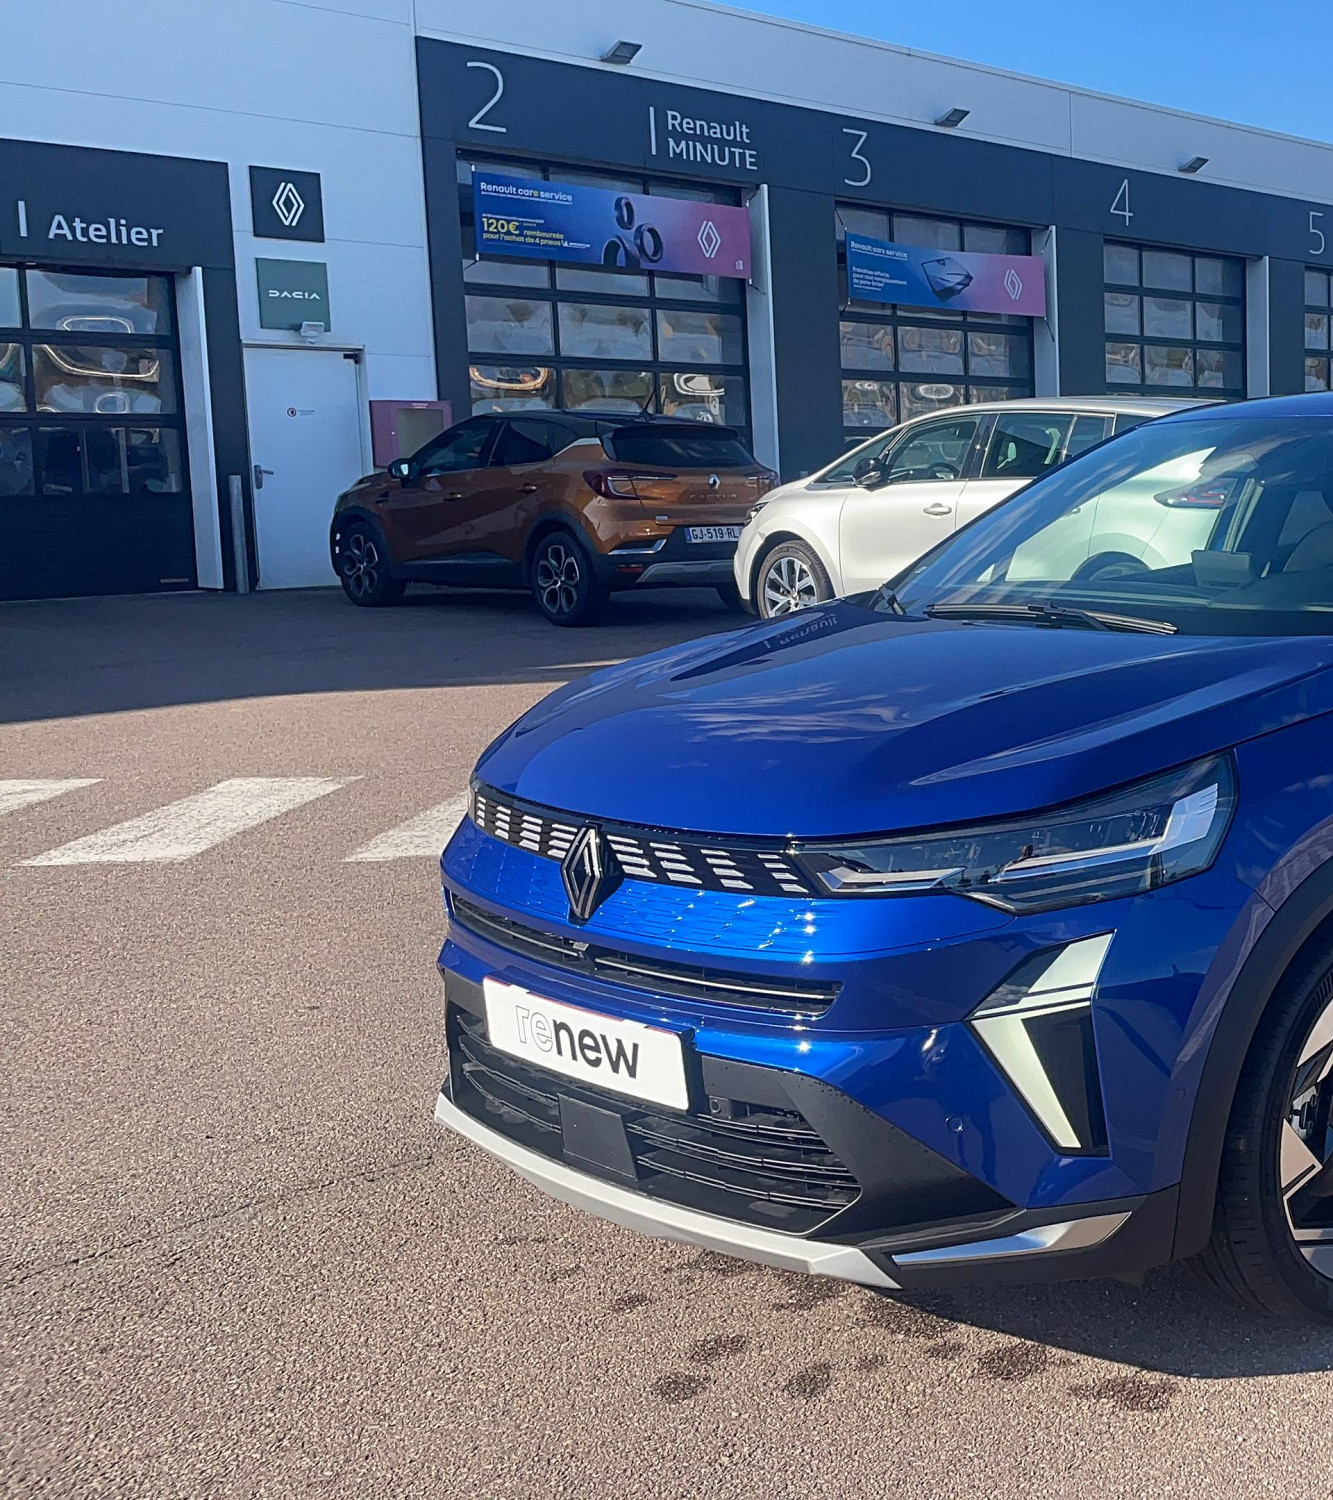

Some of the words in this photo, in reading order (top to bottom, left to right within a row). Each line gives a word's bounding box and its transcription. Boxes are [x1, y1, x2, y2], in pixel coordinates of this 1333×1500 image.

[466, 61, 507, 133] 2
[666, 110, 750, 143] Renault
[667, 138, 758, 170] MINUTE
[842, 127, 872, 187] 3
[480, 182, 516, 195] Renault
[518, 188, 540, 197] care
[540, 191, 572, 202] service
[1109, 179, 1134, 226] 4
[48, 213, 164, 248] Atelier
[482, 218, 519, 234] 120€
[1309, 211, 1325, 255] 5
[268, 289, 321, 301] DACIA
[691, 527, 739, 540] GJ-519-RL
[515, 1005, 639, 1079] renew
